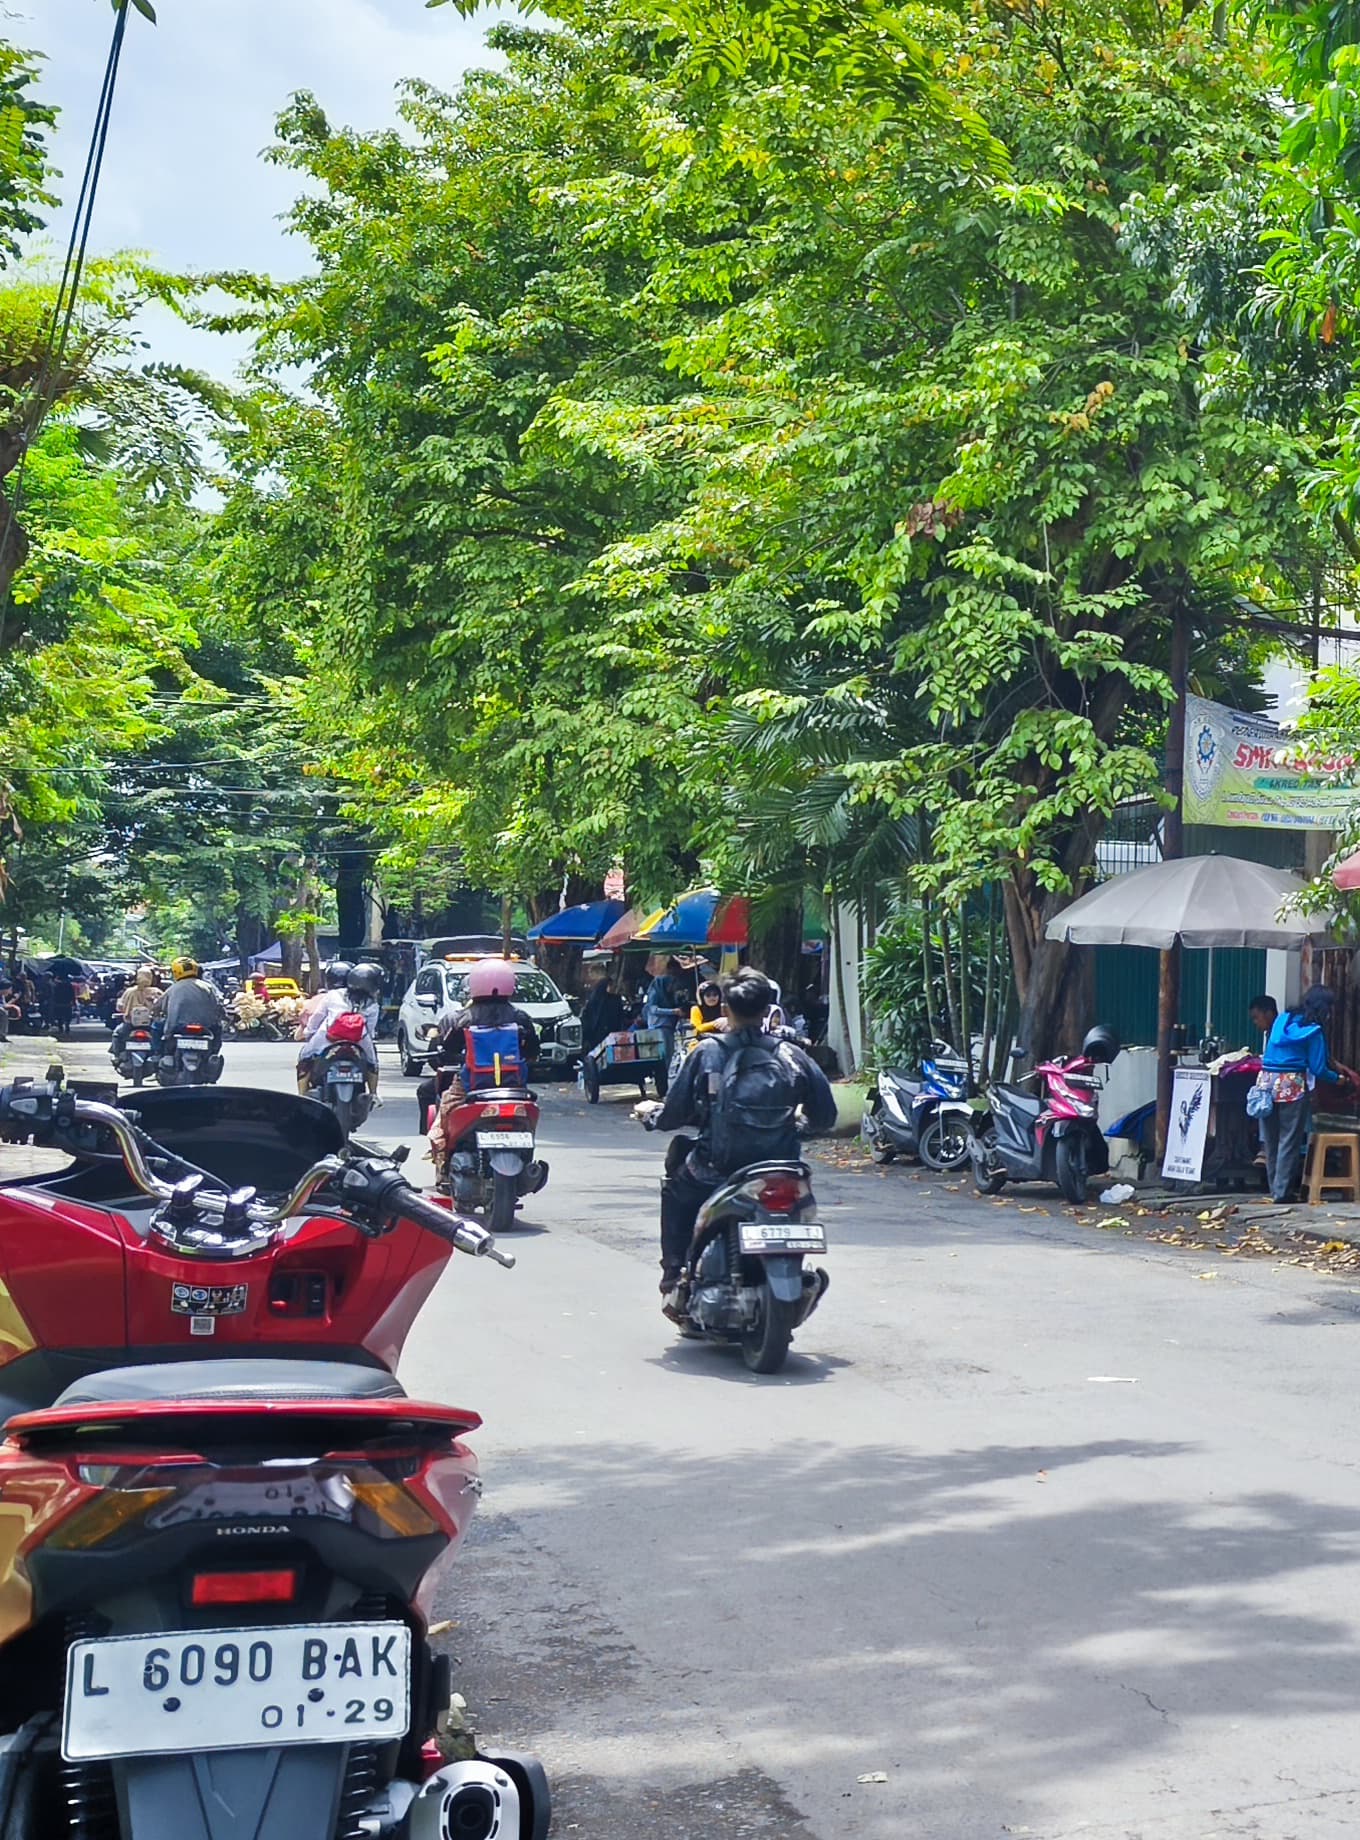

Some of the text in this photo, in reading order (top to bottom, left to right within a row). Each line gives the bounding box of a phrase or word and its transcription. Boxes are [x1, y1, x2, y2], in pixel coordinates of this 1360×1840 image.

[215, 1524, 291, 1537] HONDA
[82, 1635, 398, 1697] L 6090 BAK
